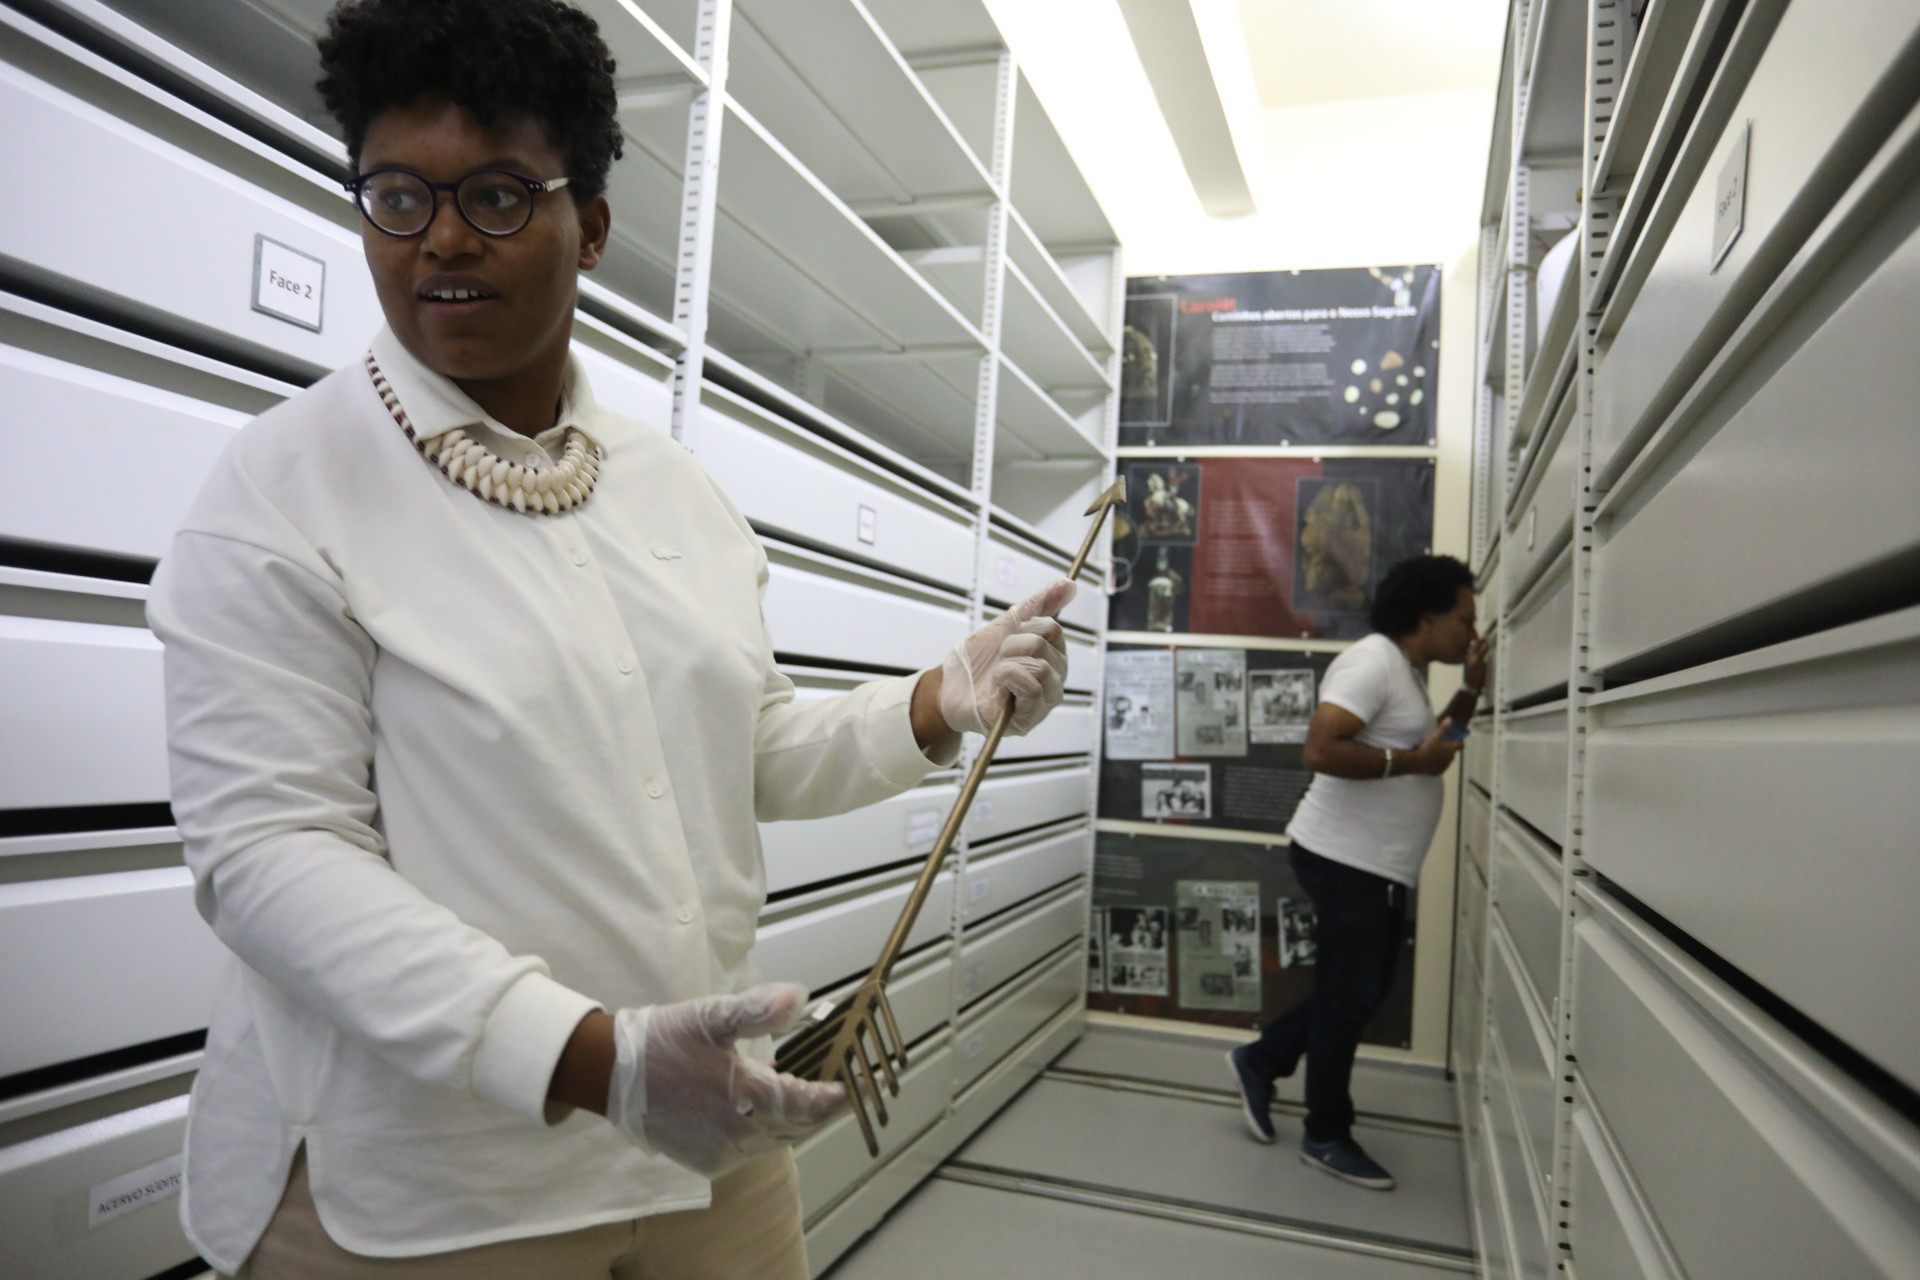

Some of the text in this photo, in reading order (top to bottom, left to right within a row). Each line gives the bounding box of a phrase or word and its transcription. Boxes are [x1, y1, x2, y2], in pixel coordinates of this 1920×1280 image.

[269, 270, 313, 300] Face 2
[1303, 307, 1329, 321] para
[96, 1188, 143, 1215] ACERVO
